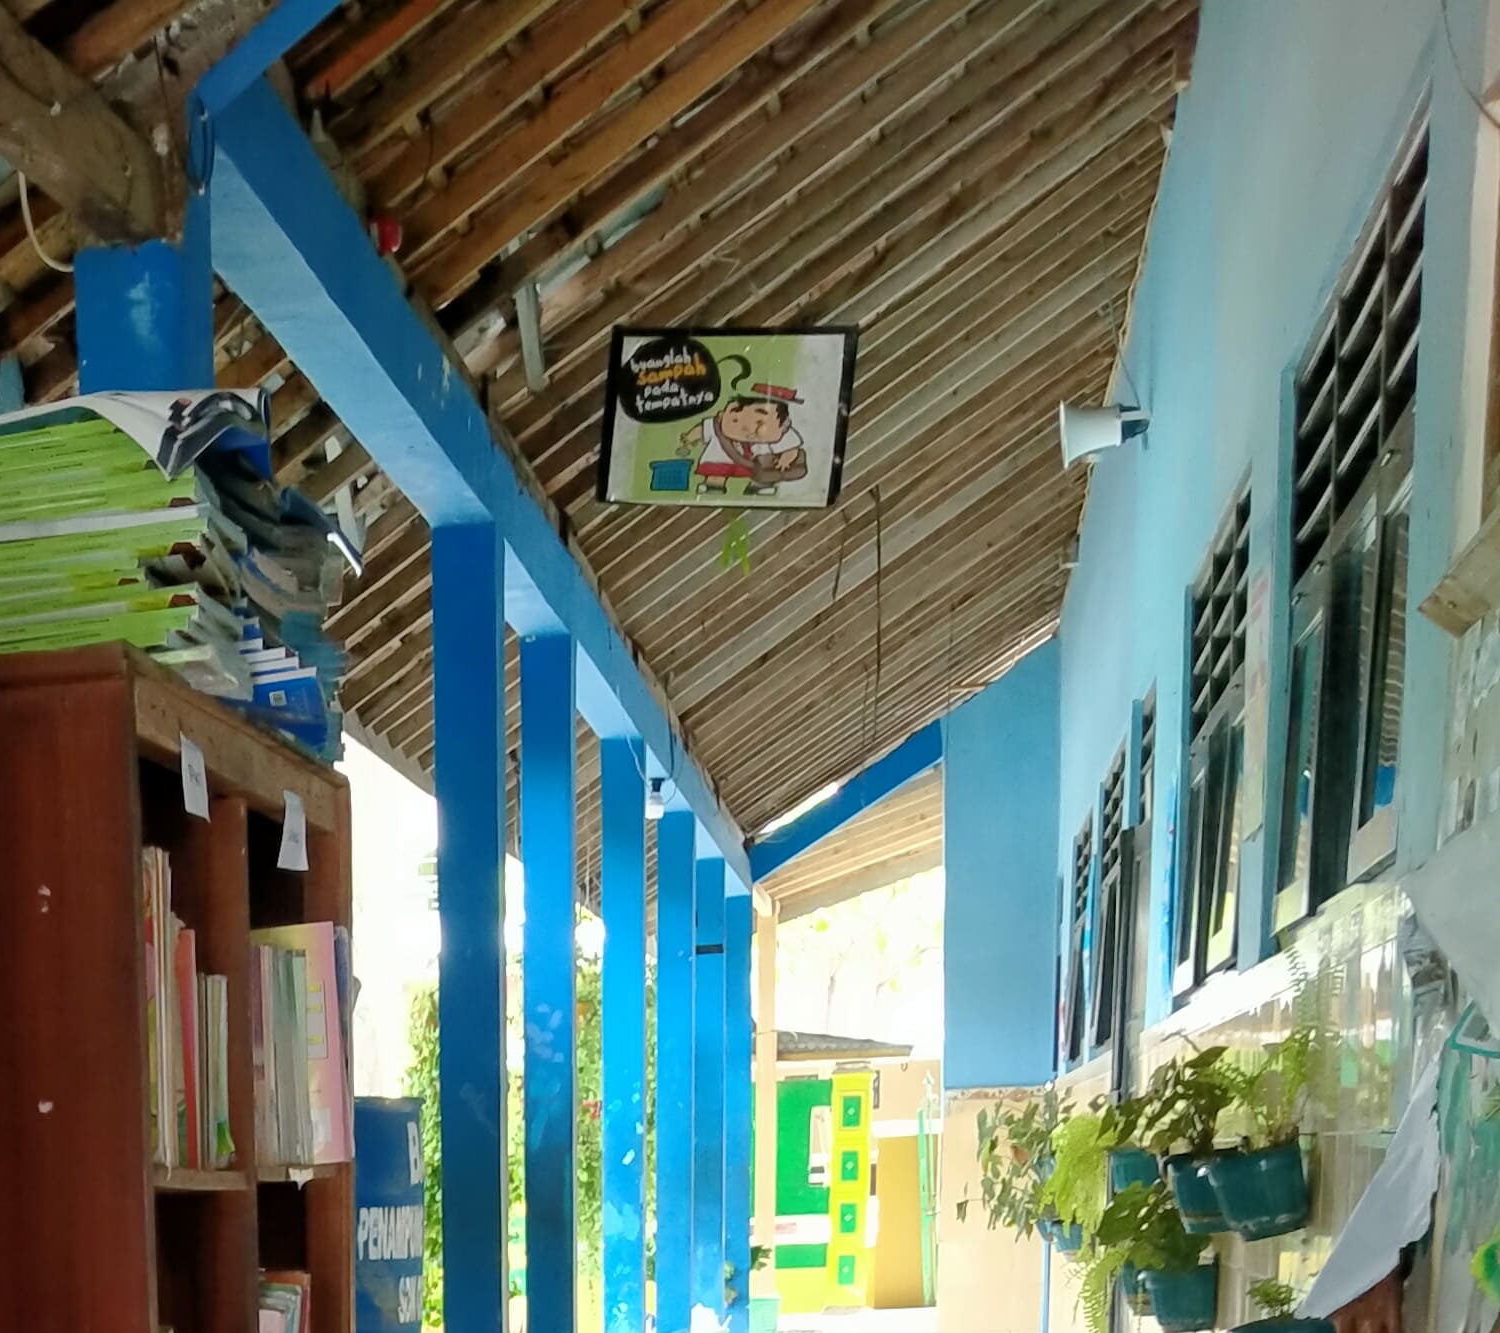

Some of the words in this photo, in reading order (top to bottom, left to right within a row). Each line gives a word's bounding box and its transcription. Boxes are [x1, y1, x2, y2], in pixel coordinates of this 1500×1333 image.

[637, 352, 707, 385] sampah
[635, 388, 714, 414] tempatnya
[644, 378, 679, 398] pada
